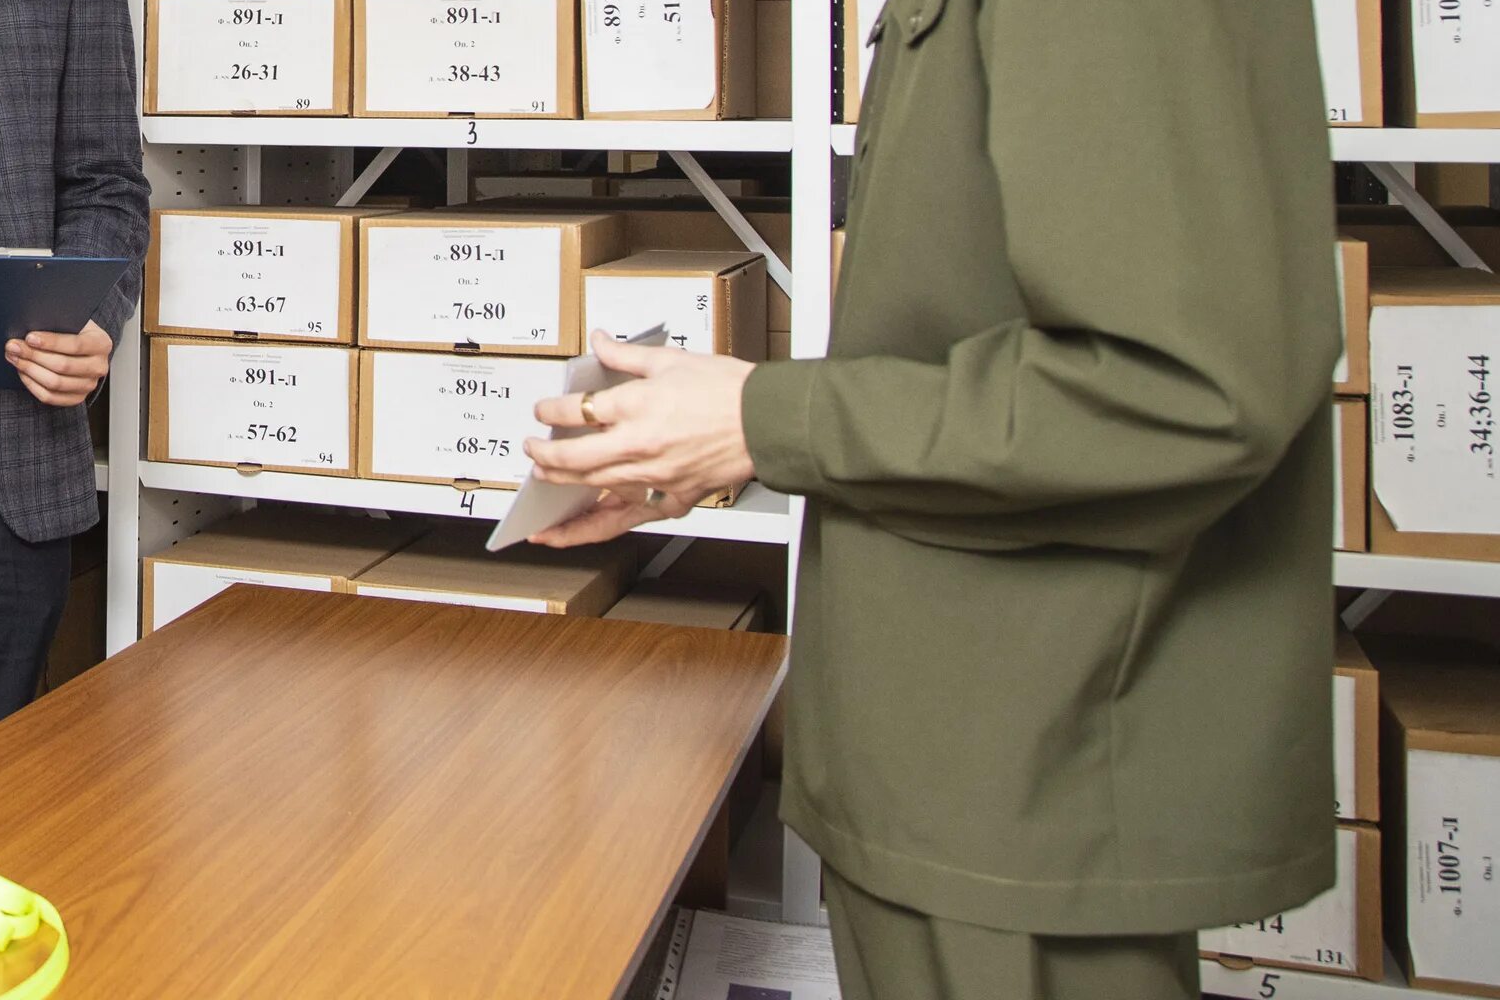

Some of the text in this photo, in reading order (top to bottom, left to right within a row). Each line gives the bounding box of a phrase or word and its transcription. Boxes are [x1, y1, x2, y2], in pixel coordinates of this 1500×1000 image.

[232, 8, 283, 25] 891-л
[446, 7, 501, 24] 891-л
[230, 63, 278, 81] 26-31
[447, 64, 501, 82] 38-43
[295, 98, 311, 110] 89
[531, 101, 545, 113] 91
[466, 121, 478, 145] 3
[233, 240, 284, 257] 891-л
[450, 244, 505, 261] 891-л
[235, 295, 286, 313] 63-67
[452, 302, 506, 320] 76-80
[696, 294, 708, 311] 98
[307, 321, 322, 333] 95
[531, 328, 546, 340] 97
[245, 368, 297, 387] 891-л
[455, 378, 510, 399] 891-л
[1391, 365, 1415, 440] 1083-л
[247, 423, 297, 443] 57-62
[456, 437, 510, 457] 68-75
[319, 452, 333, 464] 94
[459, 491, 474, 515] 4
[1437, 817, 1462, 893] 1007-л
[1316, 948, 1343, 965] 131
[1258, 973, 1281, 1000] 5
